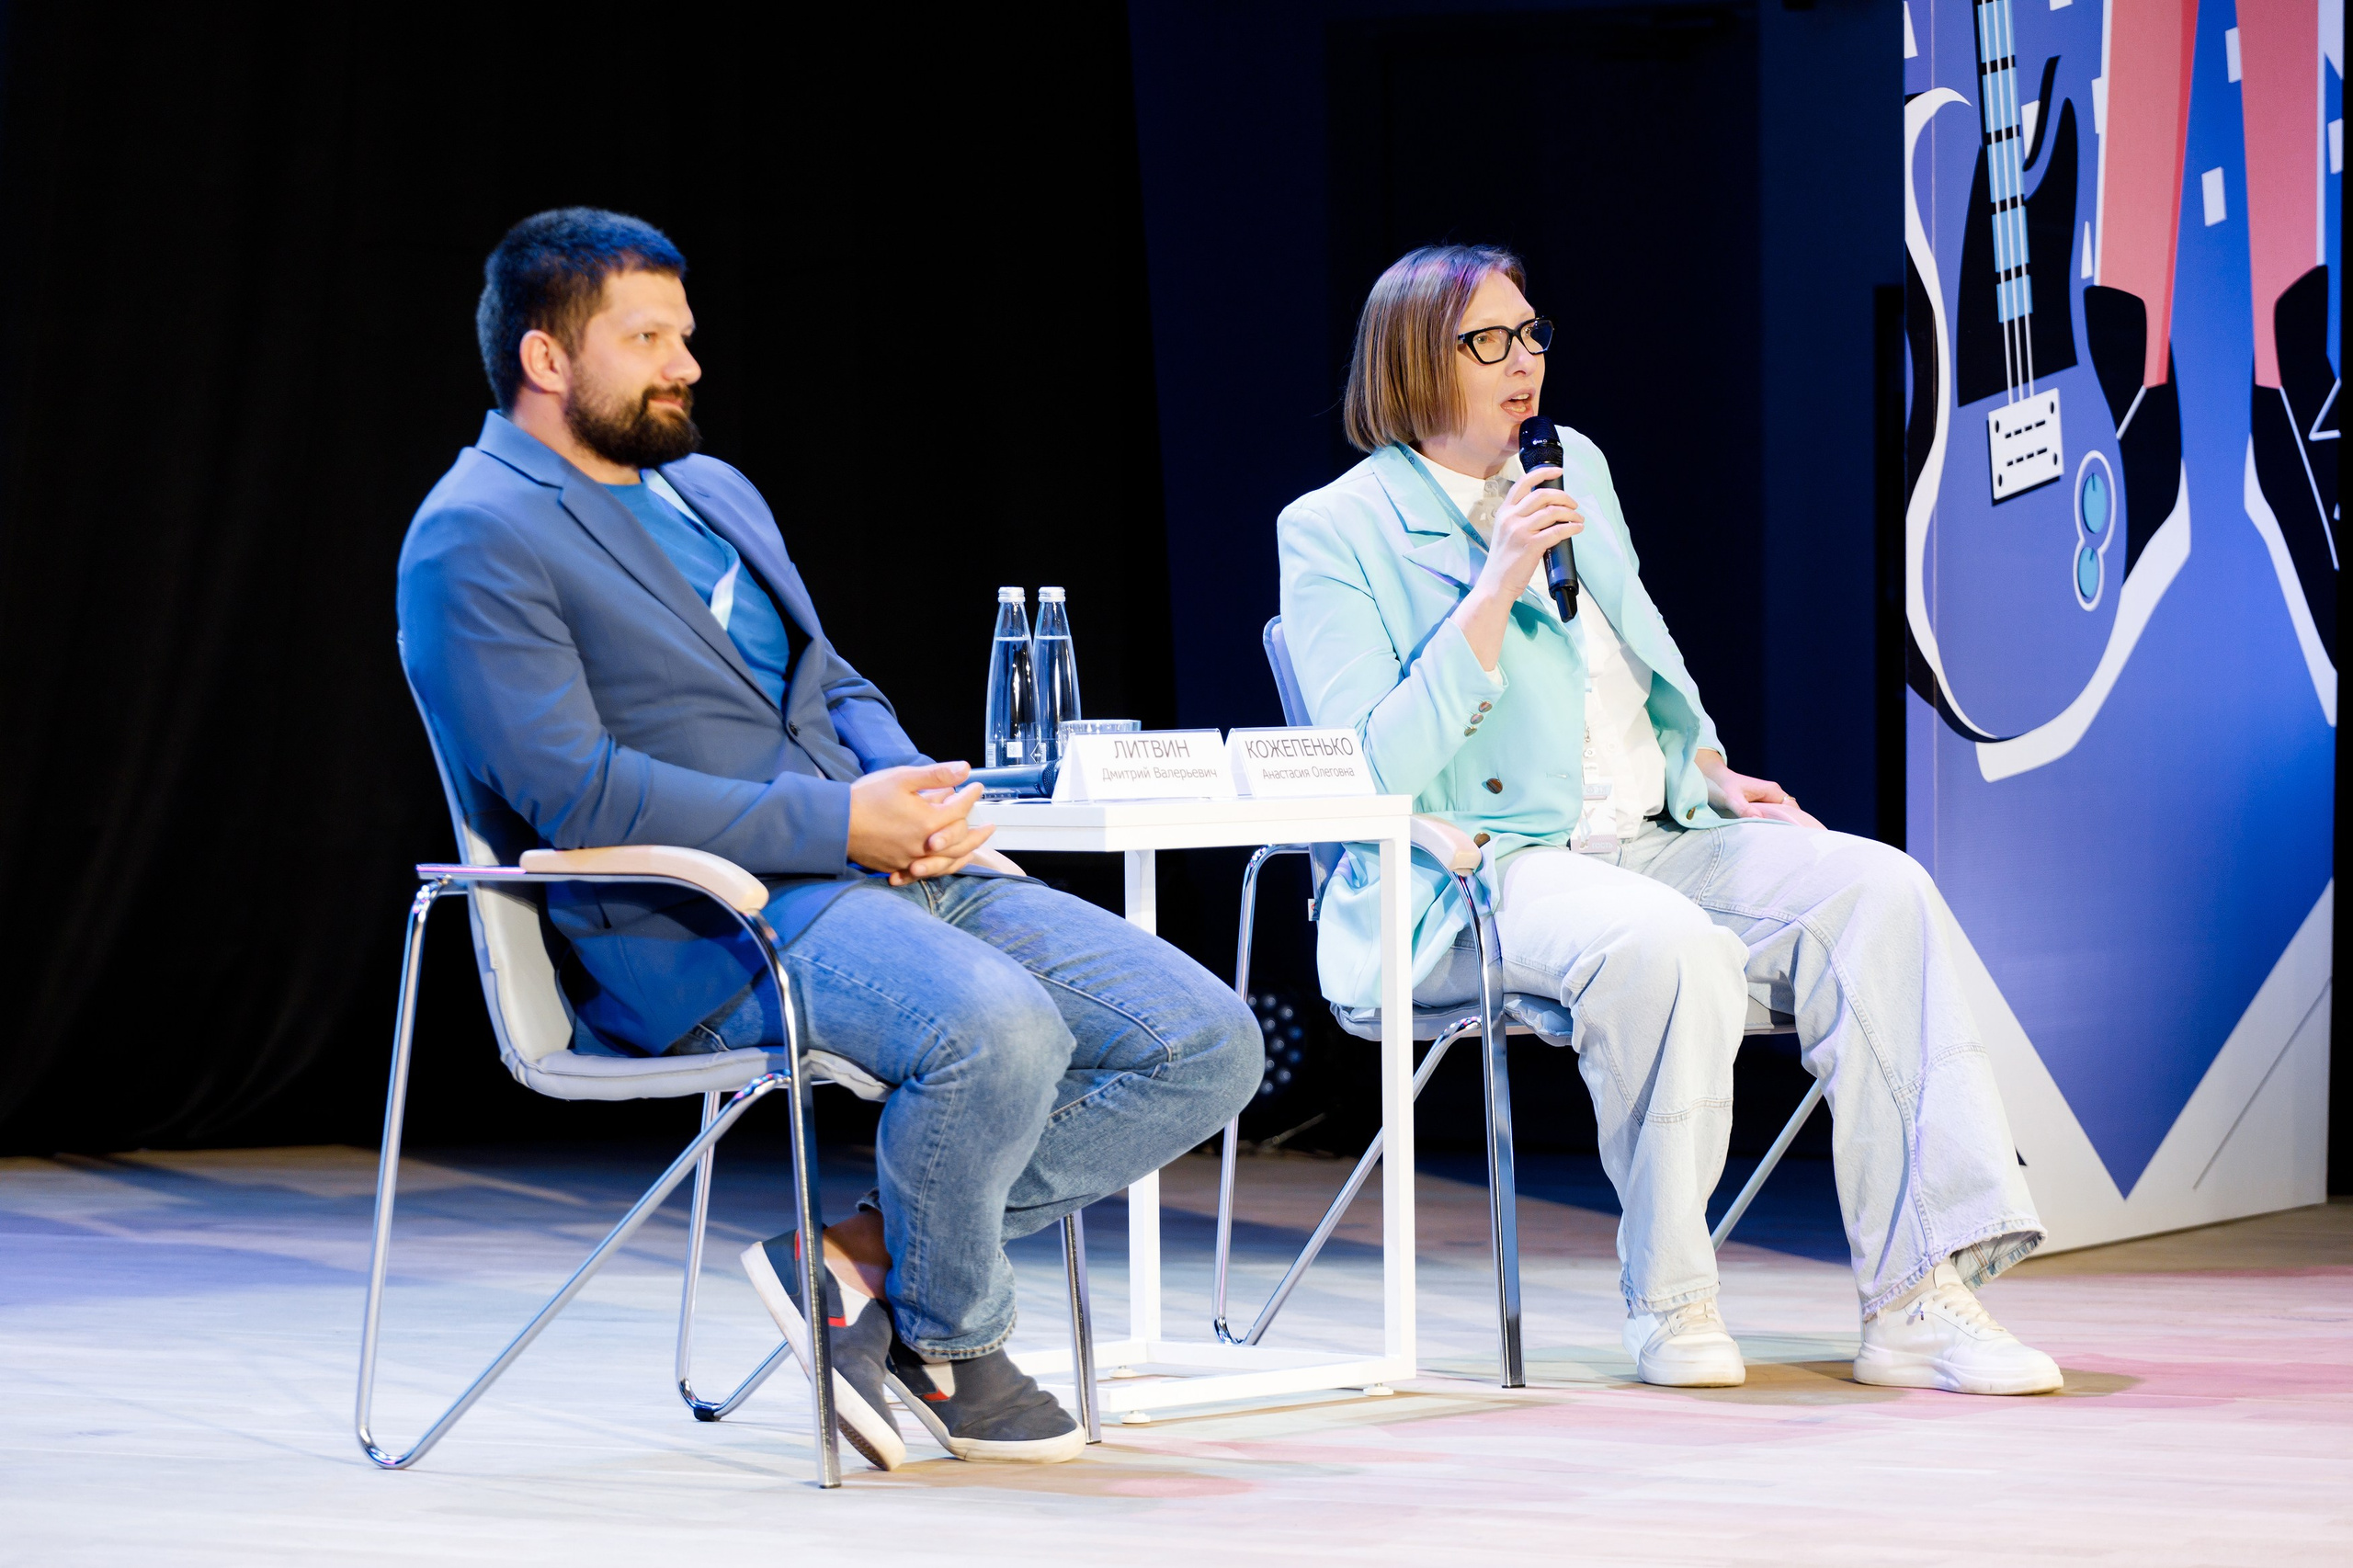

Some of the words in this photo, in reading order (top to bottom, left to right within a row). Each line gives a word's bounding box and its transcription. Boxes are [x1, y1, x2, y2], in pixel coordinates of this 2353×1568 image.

[1114, 739, 1190, 759] ЛИТВИН
[1245, 737, 1354, 759] КОЖЕПЕНЬКО
[1102, 767, 1151, 781] Дмитрий
[1153, 767, 1218, 780] Валерьевич
[1262, 768, 1310, 779] Анастасия
[1312, 766, 1355, 778] Олеговна
